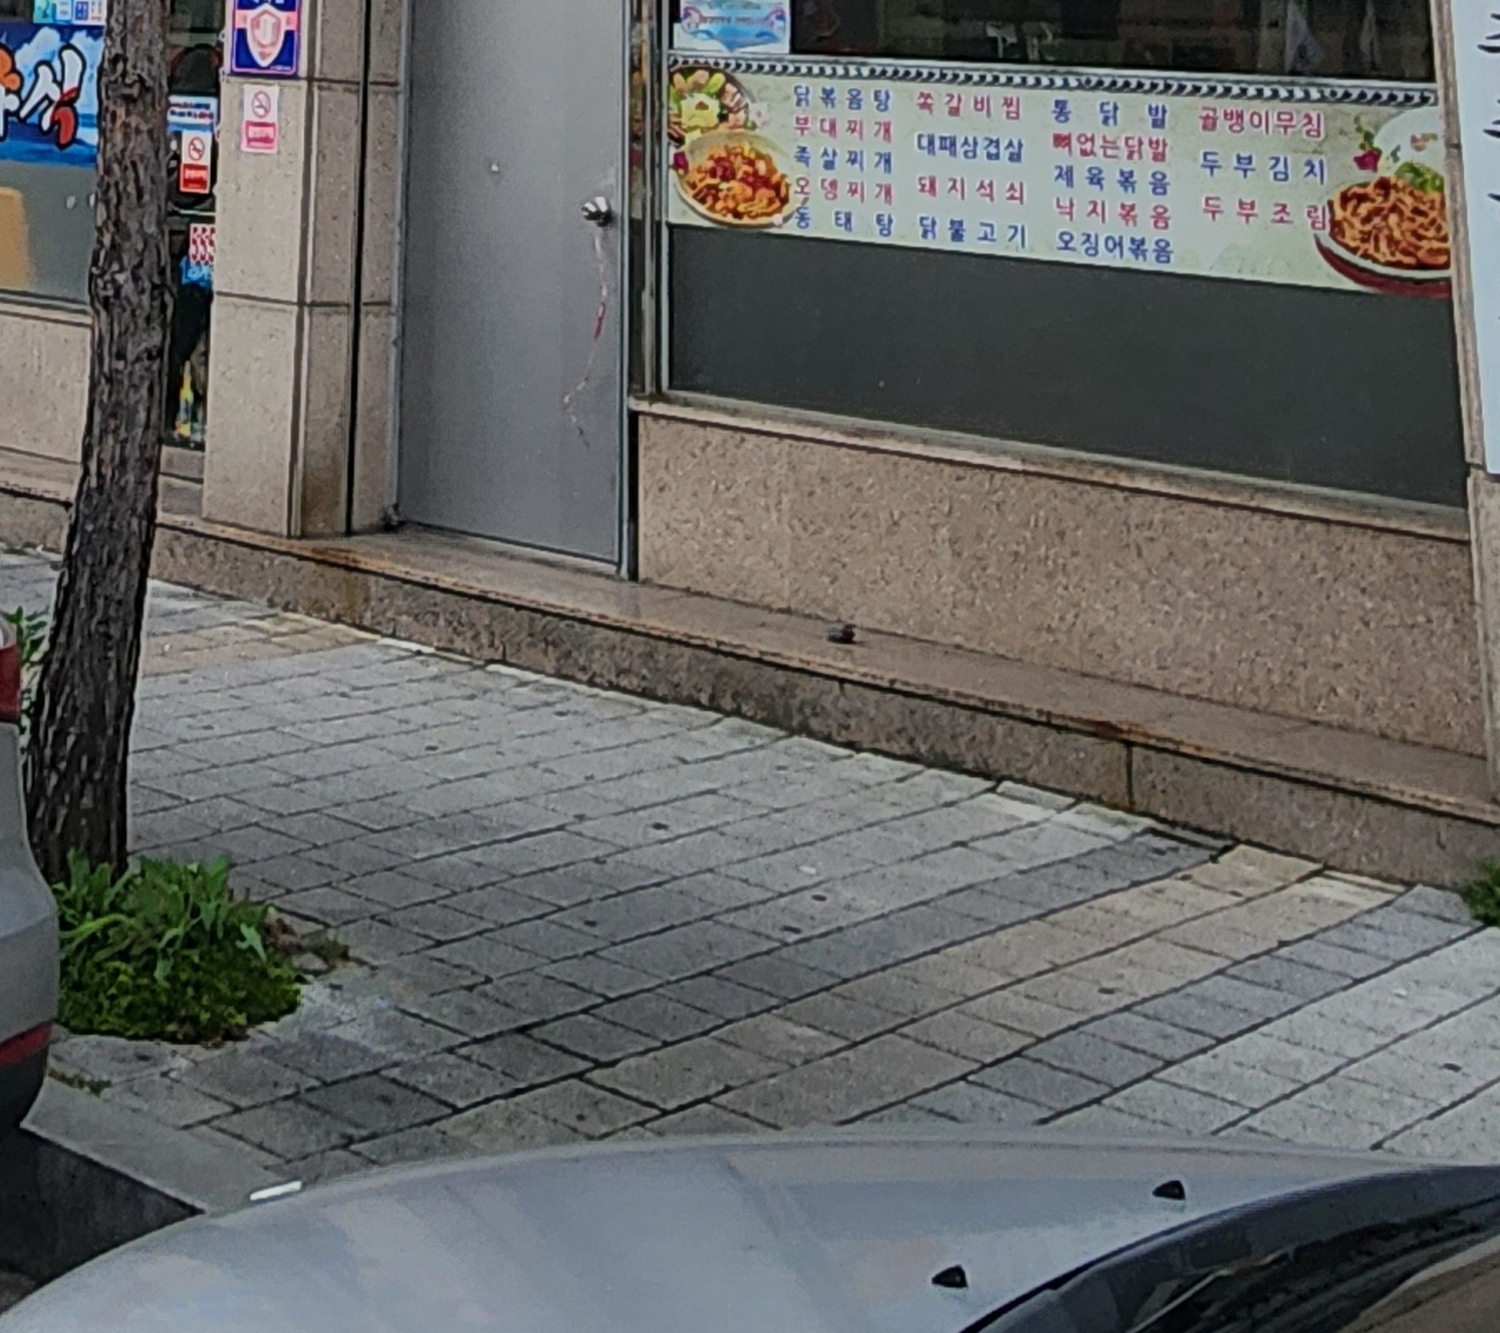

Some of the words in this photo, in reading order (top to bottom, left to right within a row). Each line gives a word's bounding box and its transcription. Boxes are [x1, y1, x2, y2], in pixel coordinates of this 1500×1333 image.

[794, 116, 892, 144] 부대찌개
[1200, 150, 1326, 185] 두부김치
[1202, 196, 1330, 231] 두부조림
